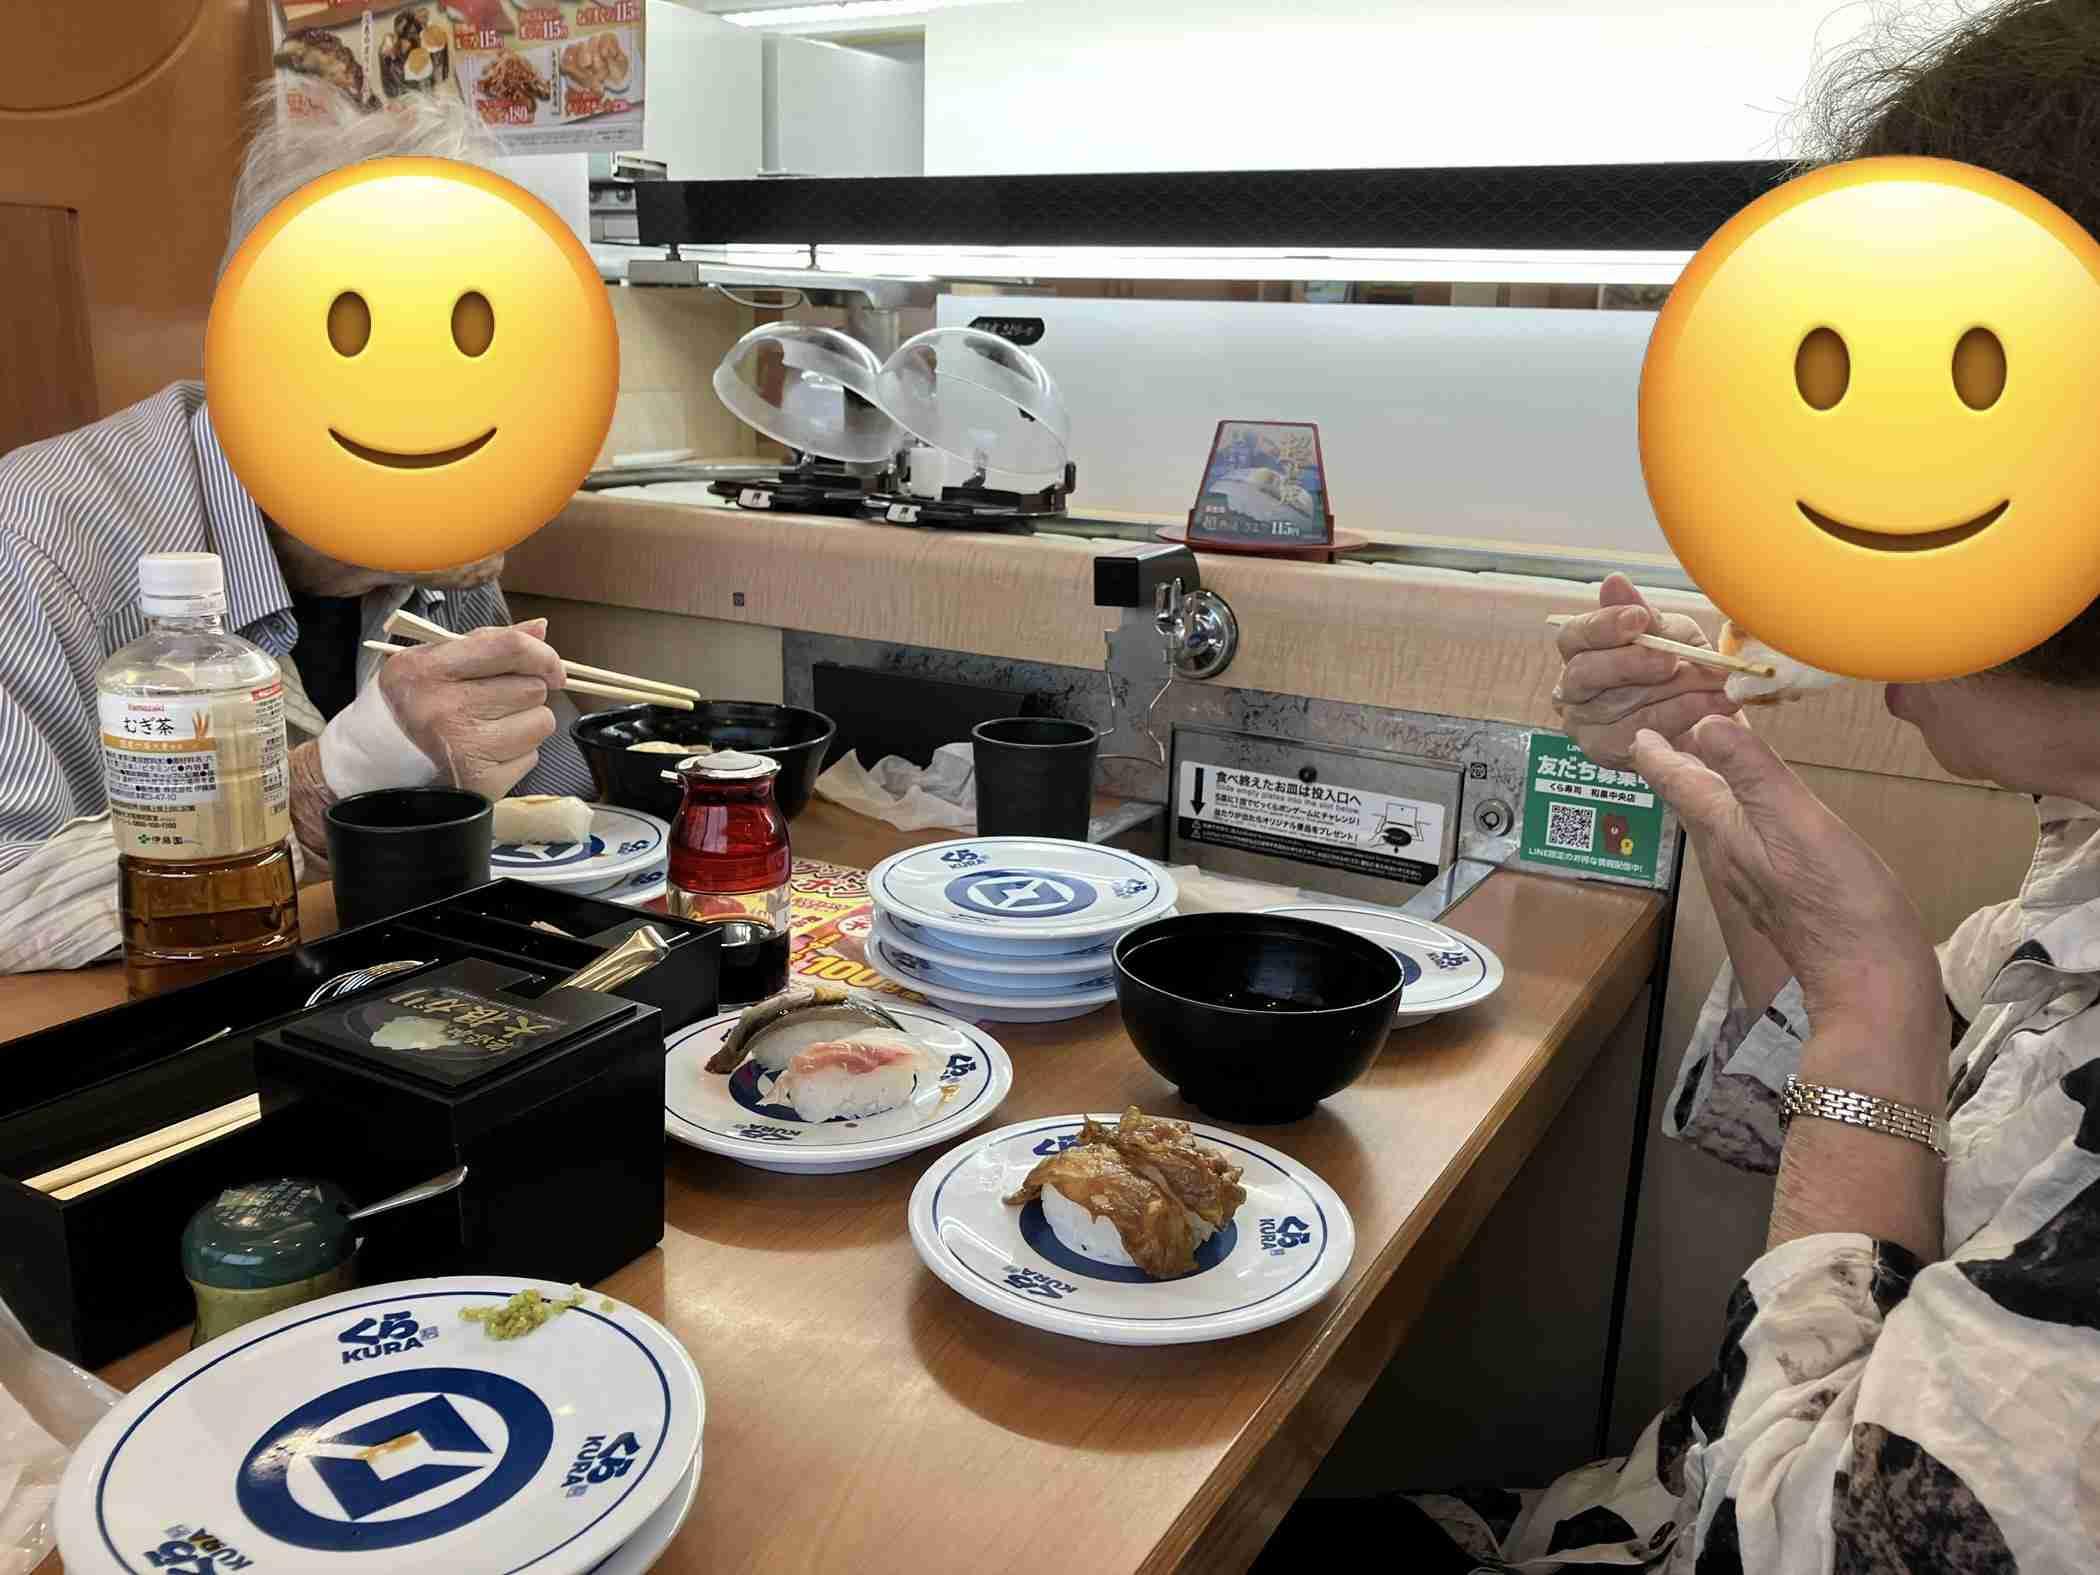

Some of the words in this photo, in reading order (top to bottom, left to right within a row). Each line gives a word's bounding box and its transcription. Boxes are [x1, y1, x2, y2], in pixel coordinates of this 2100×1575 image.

[123, 716, 174, 736] むぎ茶
[1215, 771, 1362, 806] 食べ終えたお皿は投入口へ
[1259, 1218, 1277, 1250] KURA
[1021, 1267, 1079, 1294] KURA
[337, 1310, 420, 1345] くら
[341, 1336, 425, 1365] KURA
[560, 1434, 607, 1488] KURA
[187, 1527, 255, 1571] KURA
